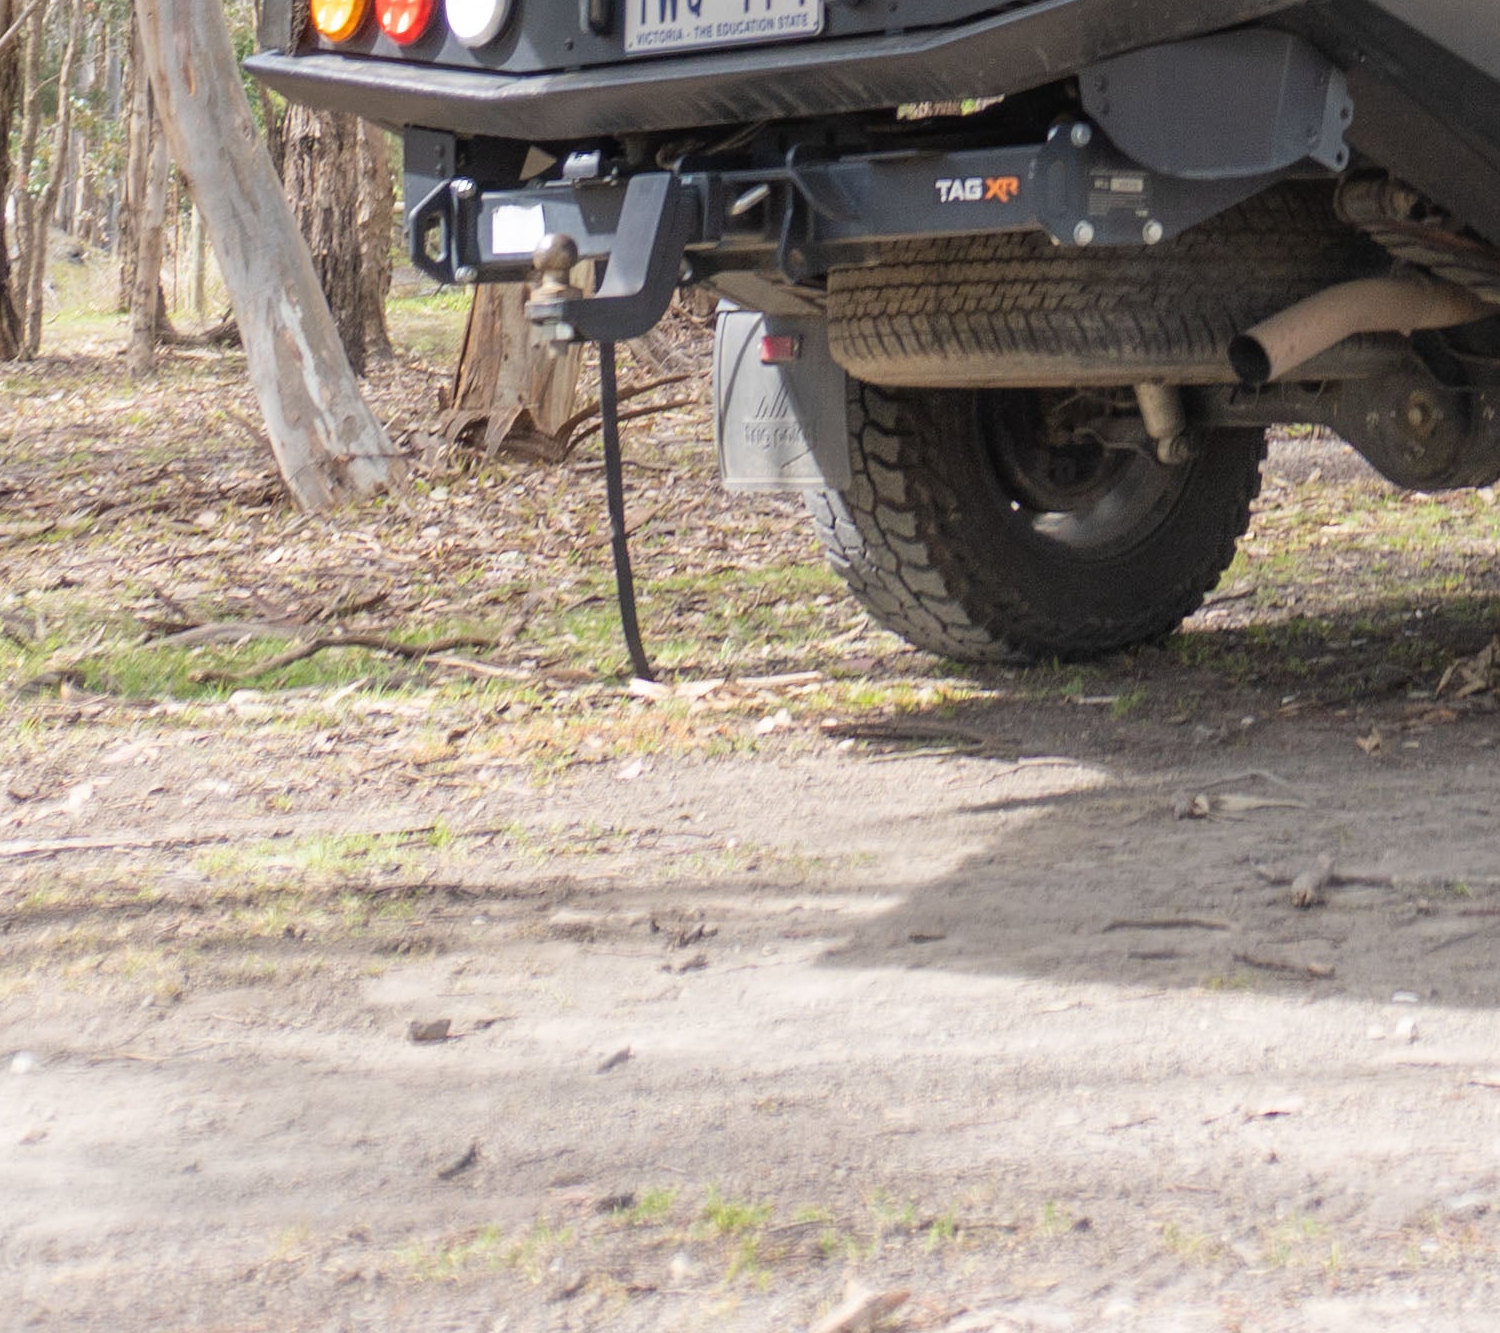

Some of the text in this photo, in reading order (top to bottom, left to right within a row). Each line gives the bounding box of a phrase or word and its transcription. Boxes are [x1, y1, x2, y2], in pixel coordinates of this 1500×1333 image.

[636, 27, 684, 46] VICTORIA
[694, 25, 713, 39] THE
[716, 18, 774, 37] EDUCATION
[777, 13, 809, 30] STATE
[935, 177, 983, 203] TAG
